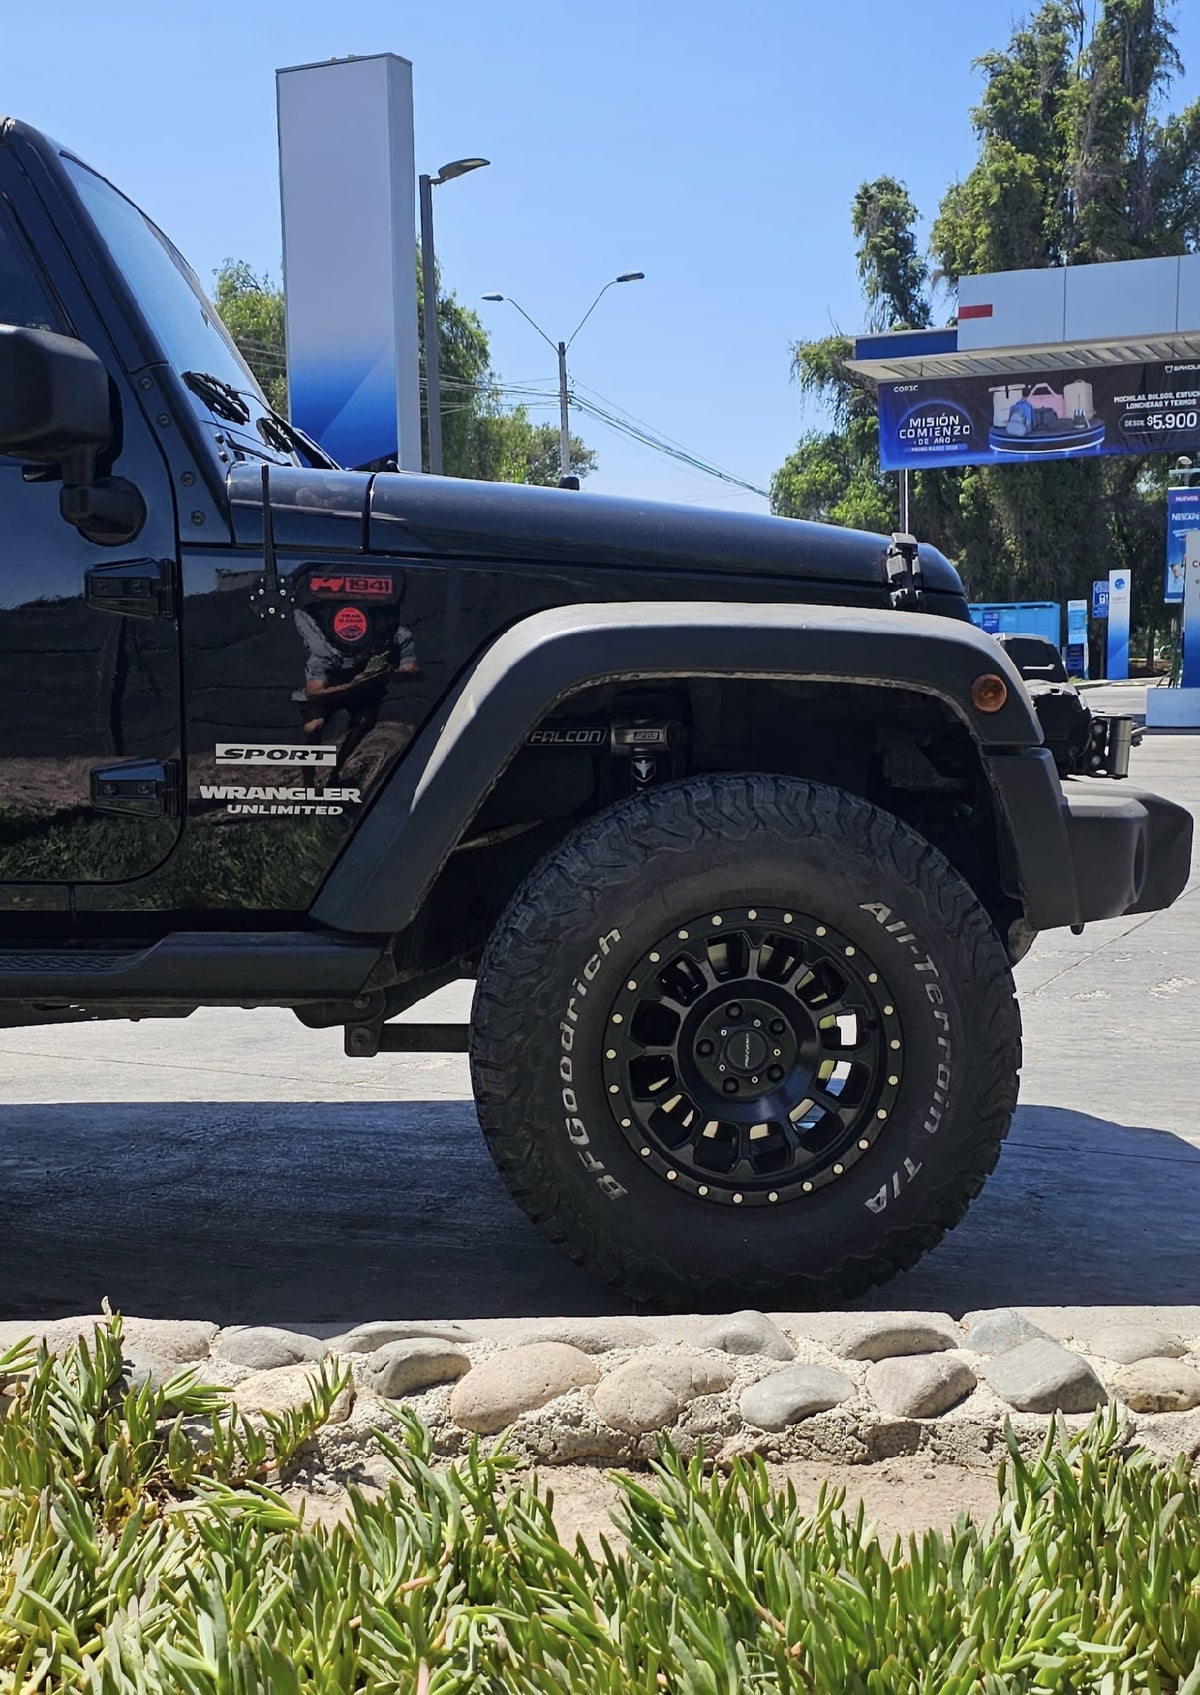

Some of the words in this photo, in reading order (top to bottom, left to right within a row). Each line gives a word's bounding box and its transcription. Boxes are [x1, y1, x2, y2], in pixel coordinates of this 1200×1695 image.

[909, 412, 959, 428] MISIÓN
[1146, 412, 1198, 430] $5.900
[899, 425, 970, 439] COMIENZO
[933, 436, 951, 444] AÑO
[349, 579, 390, 593] 1941
[530, 730, 601, 743] FALCON
[218, 747, 334, 762] SPORT
[200, 785, 362, 803] WRANGLER
[227, 804, 344, 815] UNLIMITED
[559, 927, 628, 1201] BFGoodrich
[863, 1155, 923, 1214] T/A
